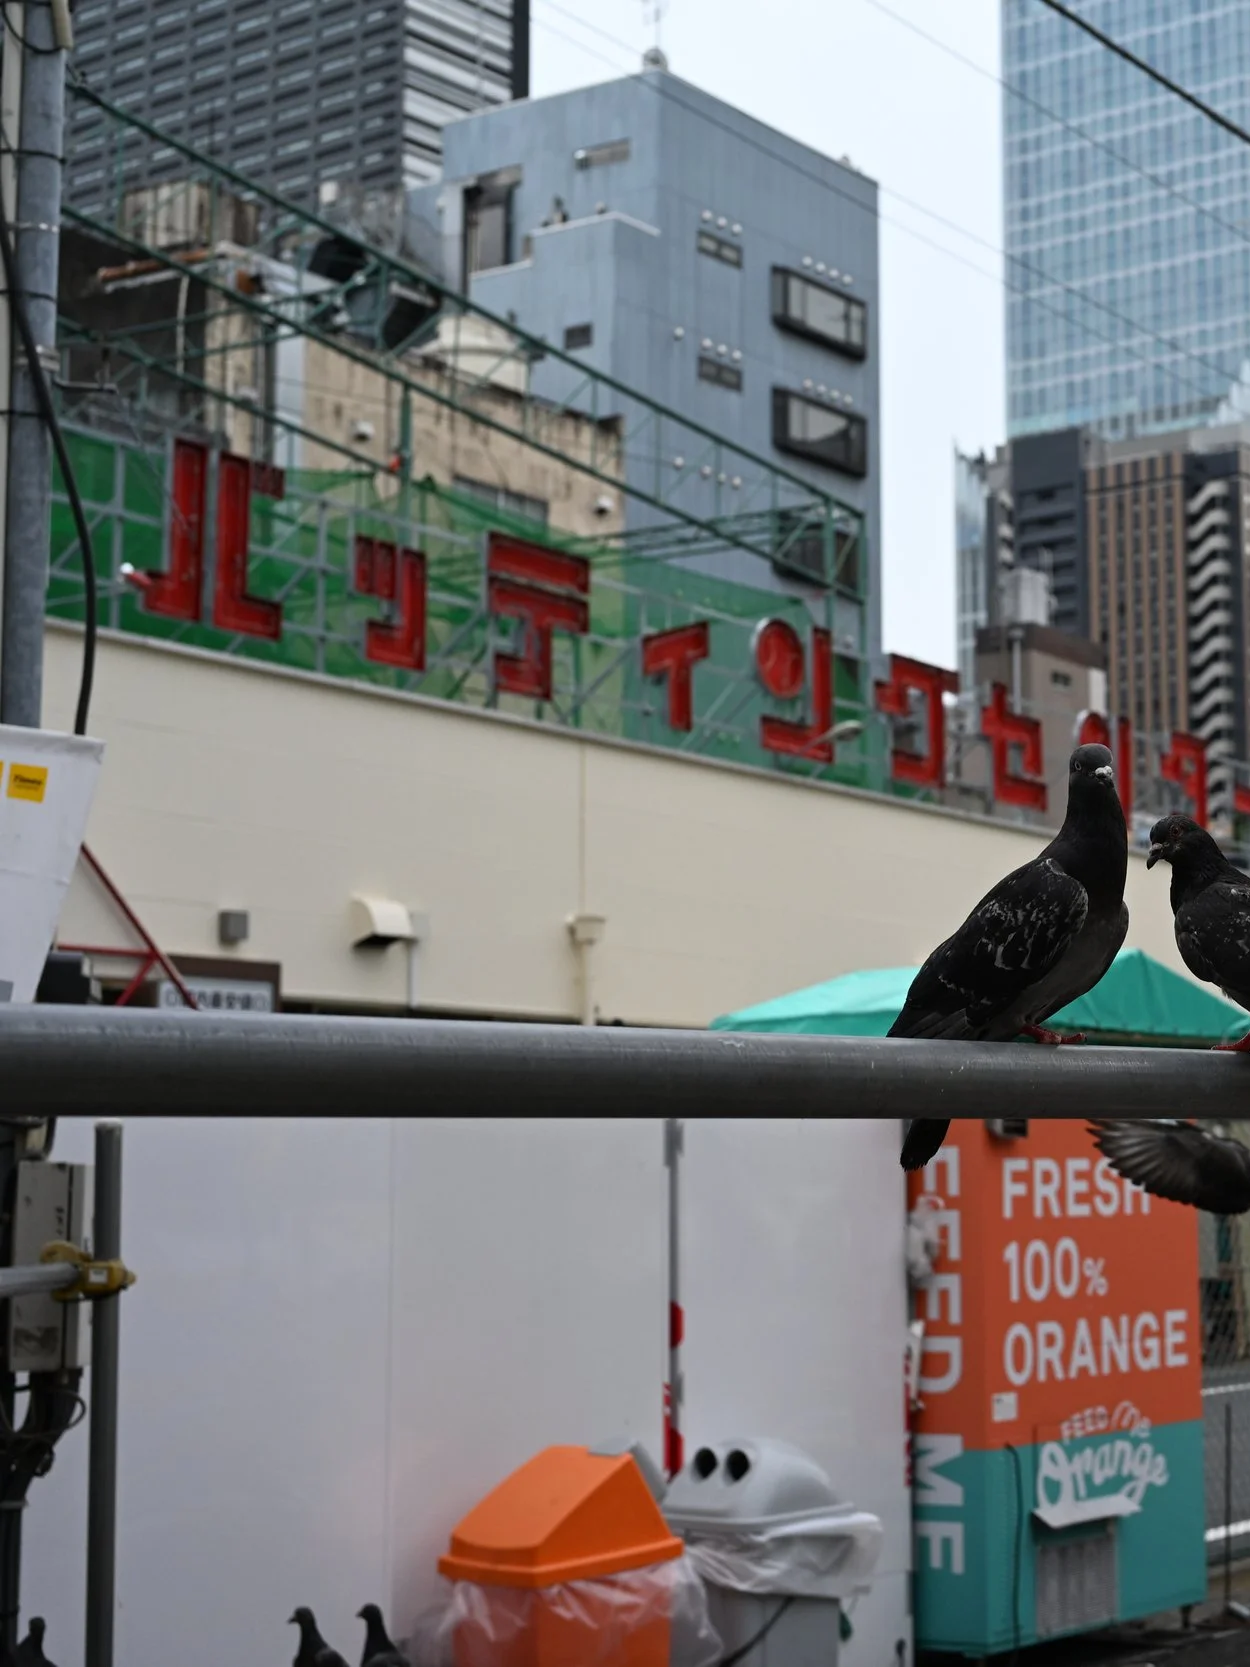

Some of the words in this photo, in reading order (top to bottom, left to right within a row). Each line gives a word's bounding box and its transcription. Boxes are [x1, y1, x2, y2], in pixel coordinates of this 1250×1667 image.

[1001, 1157, 1152, 1219] FRESH
[916, 1145, 963, 1394] FEED
[1003, 1237, 1109, 1303] 100%
[1003, 1310, 1188, 1387] ORANGE
[912, 1433, 965, 1576] ME
[1036, 1440, 1170, 1515] Orange
